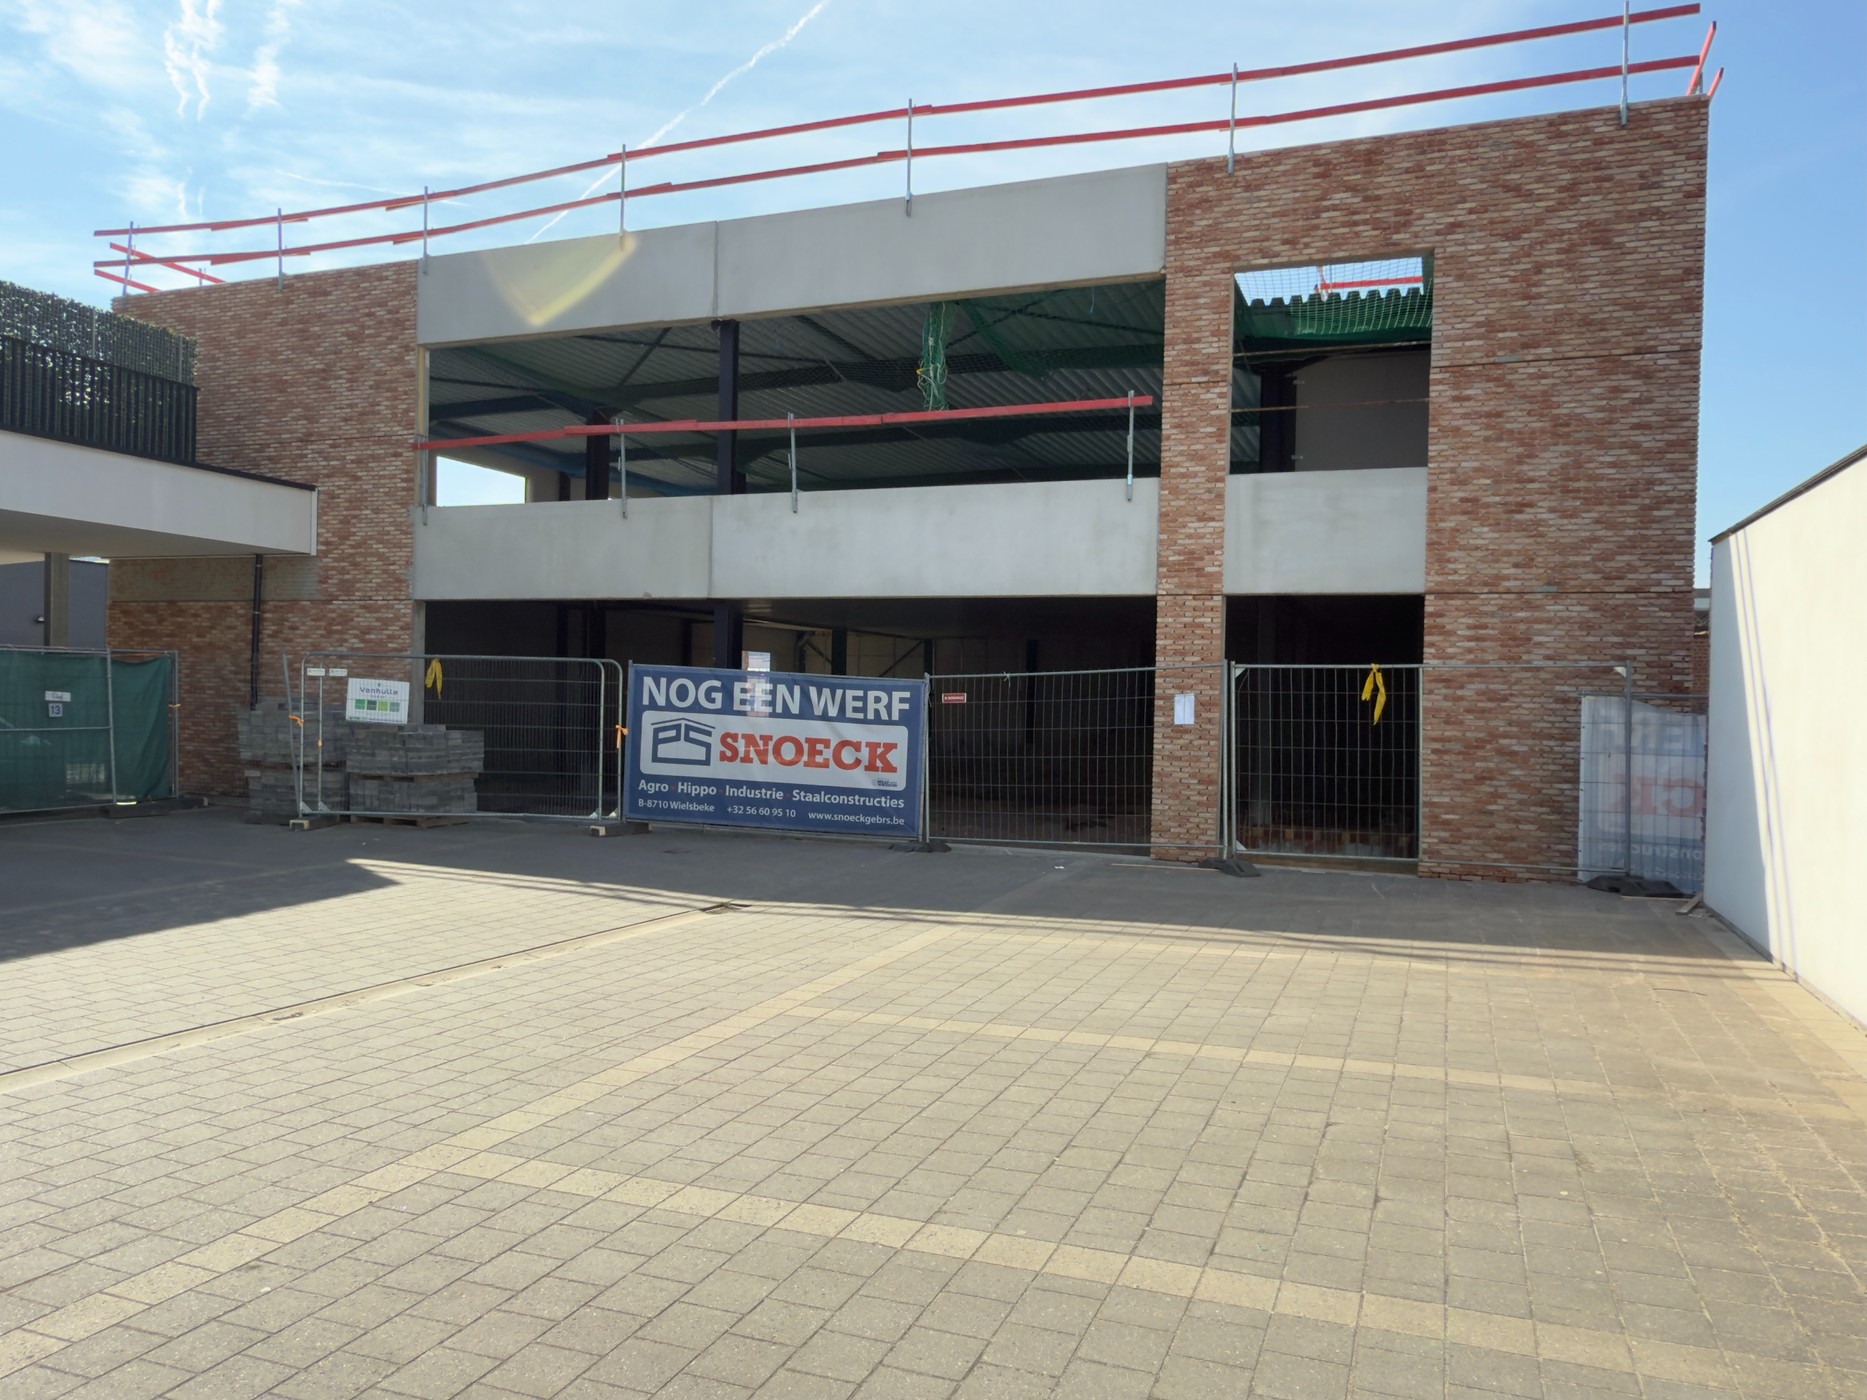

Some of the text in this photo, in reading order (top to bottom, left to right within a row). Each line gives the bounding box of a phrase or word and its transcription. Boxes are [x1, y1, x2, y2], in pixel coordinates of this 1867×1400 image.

[51, 704, 61, 715] 13
[642, 676, 911, 720] NOG EEN WERF
[719, 731, 898, 773] SNOECK
[638, 779, 905, 808] Agro Hippo Industrie Staalconstructies
[638, 798, 905, 825] B-8710 Wielsbeke +32 56 60 95 10 www.snoeckgebrs.be
